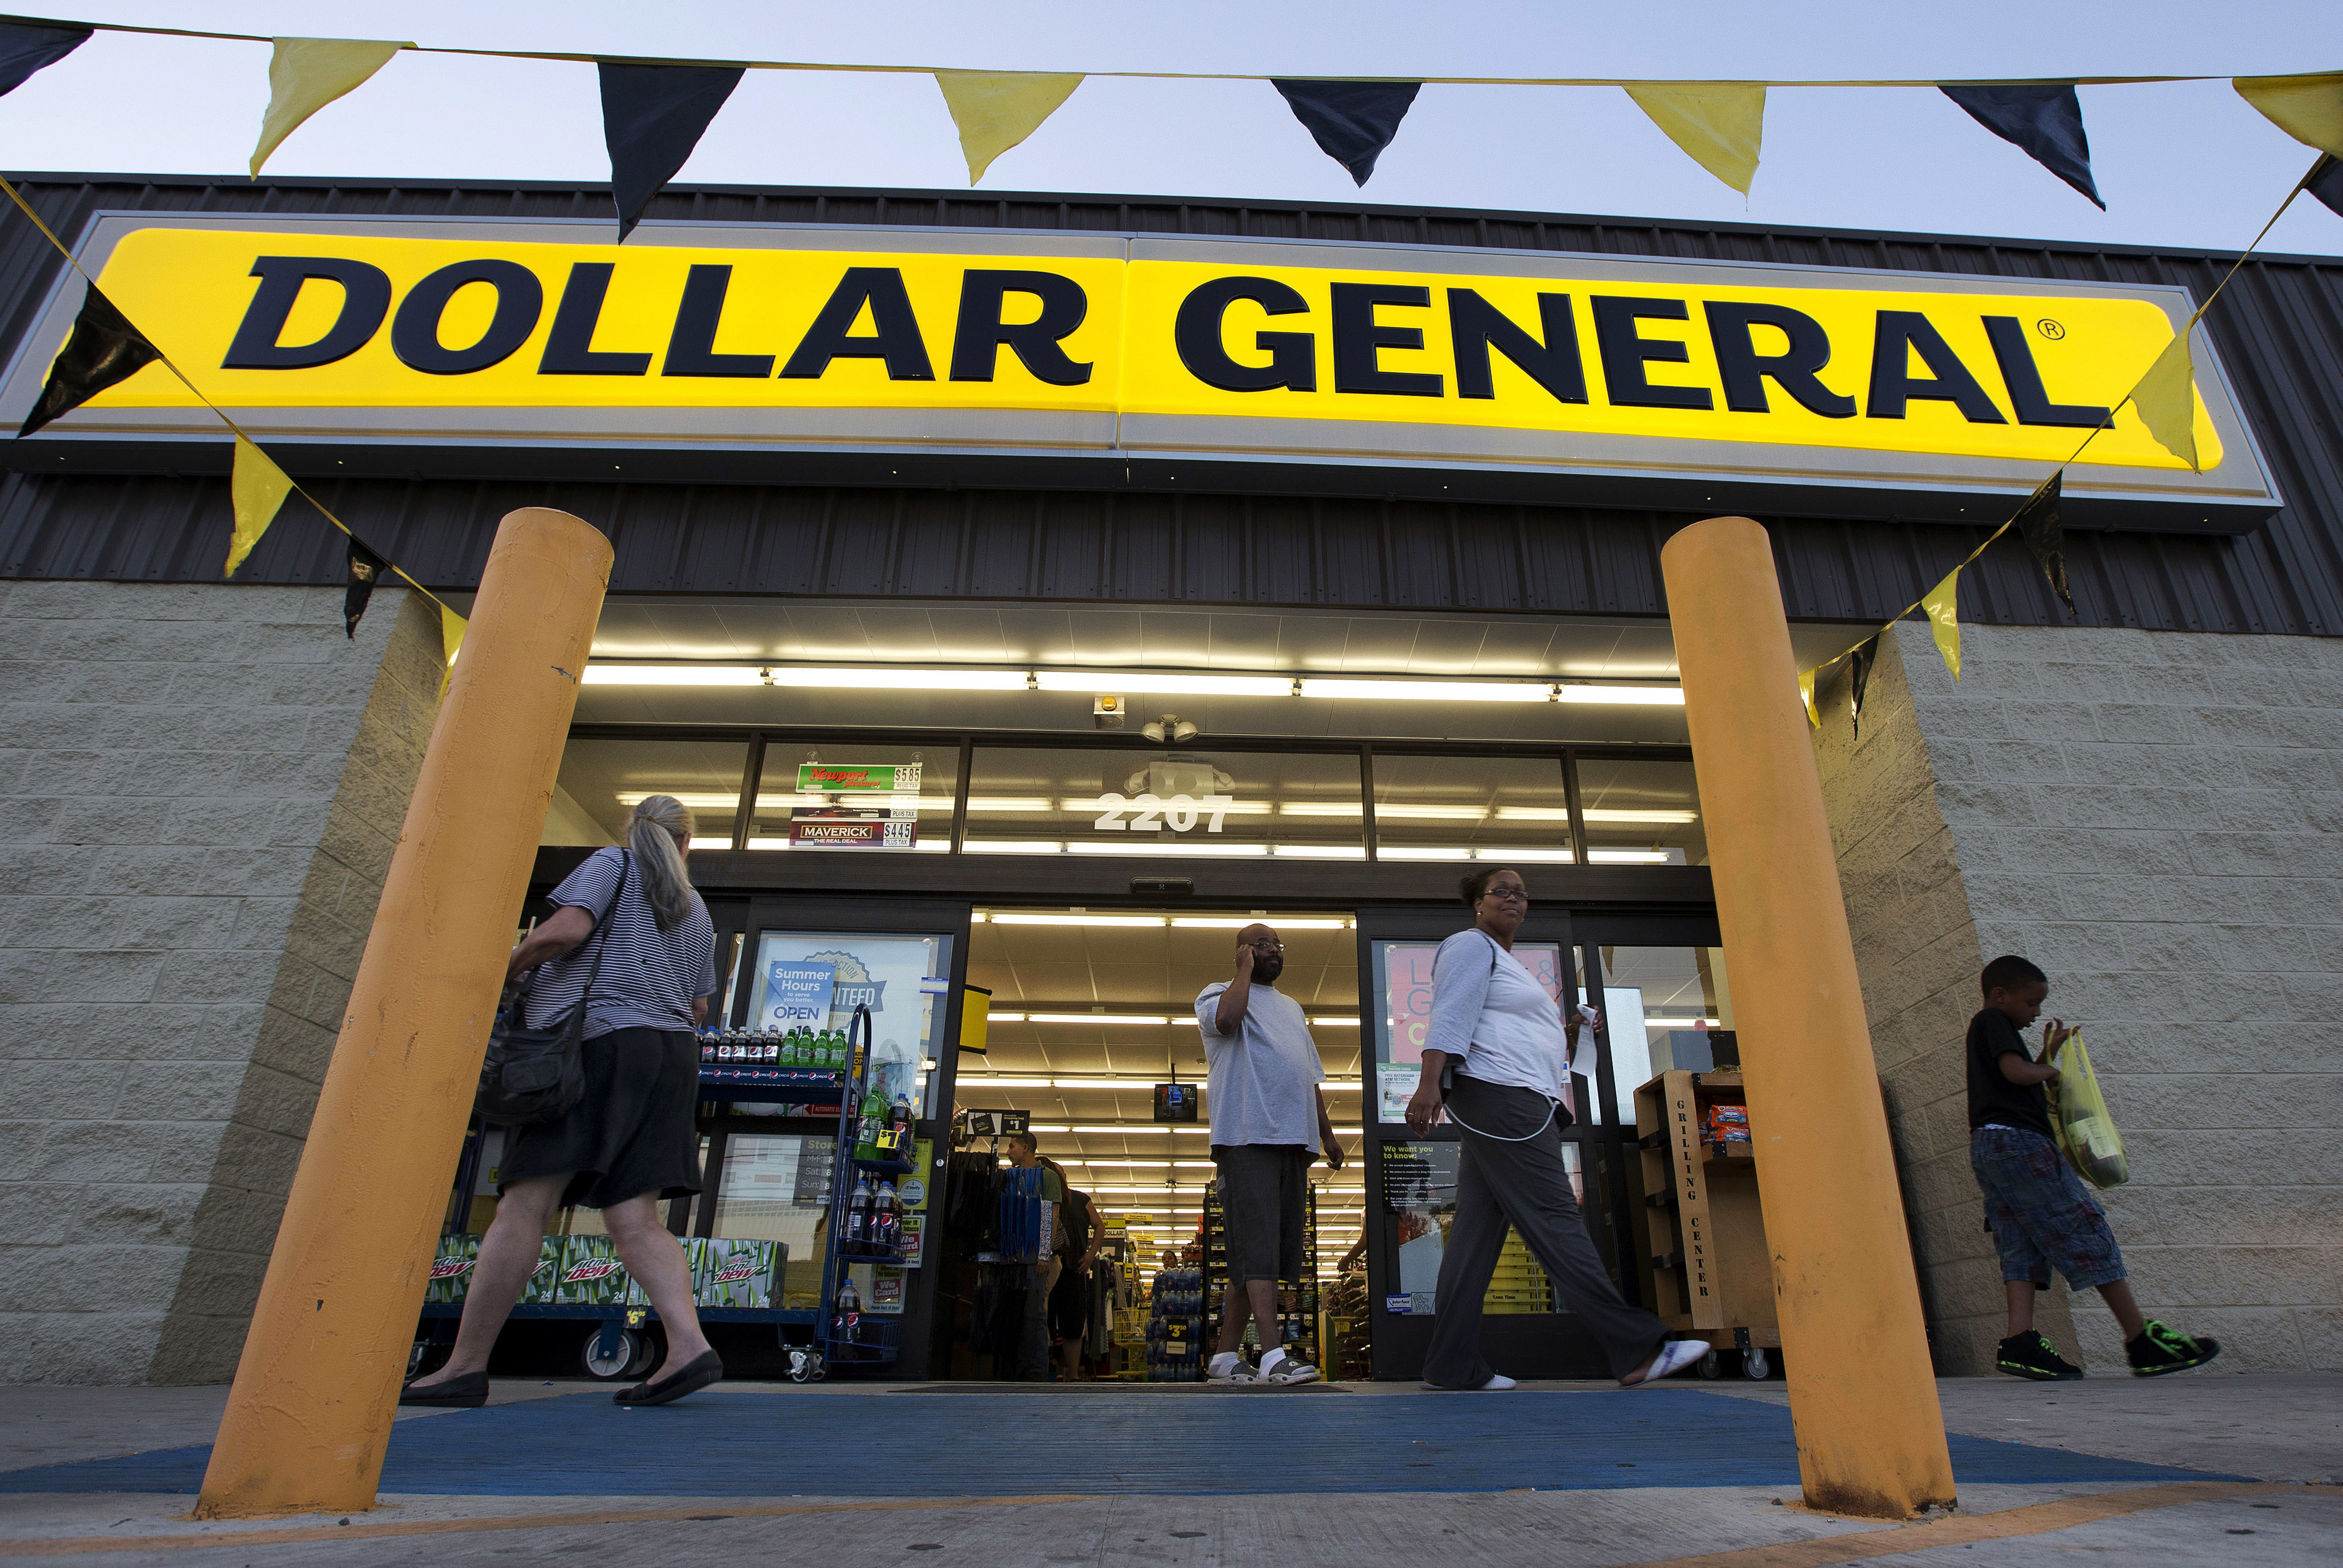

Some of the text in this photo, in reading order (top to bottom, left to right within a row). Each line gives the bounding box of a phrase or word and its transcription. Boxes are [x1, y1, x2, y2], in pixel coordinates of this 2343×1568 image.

[220, 255, 1093, 385] DOLLAR
[1174, 276, 2115, 429] GENERAL
[809, 767, 869, 783] Newport
[843, 780, 880, 788] pleasure!
[1094, 793, 1233, 833] 2207
[804, 827, 869, 837] MAVERICK
[775, 968, 831, 980] Summer
[781, 980, 820, 991] Hours
[774, 1006, 820, 1020] OPEN
[881, 1130, 897, 1147] $1
[807, 1140, 838, 1150] Store
[1677, 1100, 1696, 1200] GRILLING
[805, 1167, 820, 1176] Sat:
[900, 1242, 918, 1251] ard
[1691, 1217, 1709, 1296] CENTER
[879, 1281, 895, 1289] We
[875, 1287, 899, 1297] Card
[758, 1295, 767, 1303] 24
